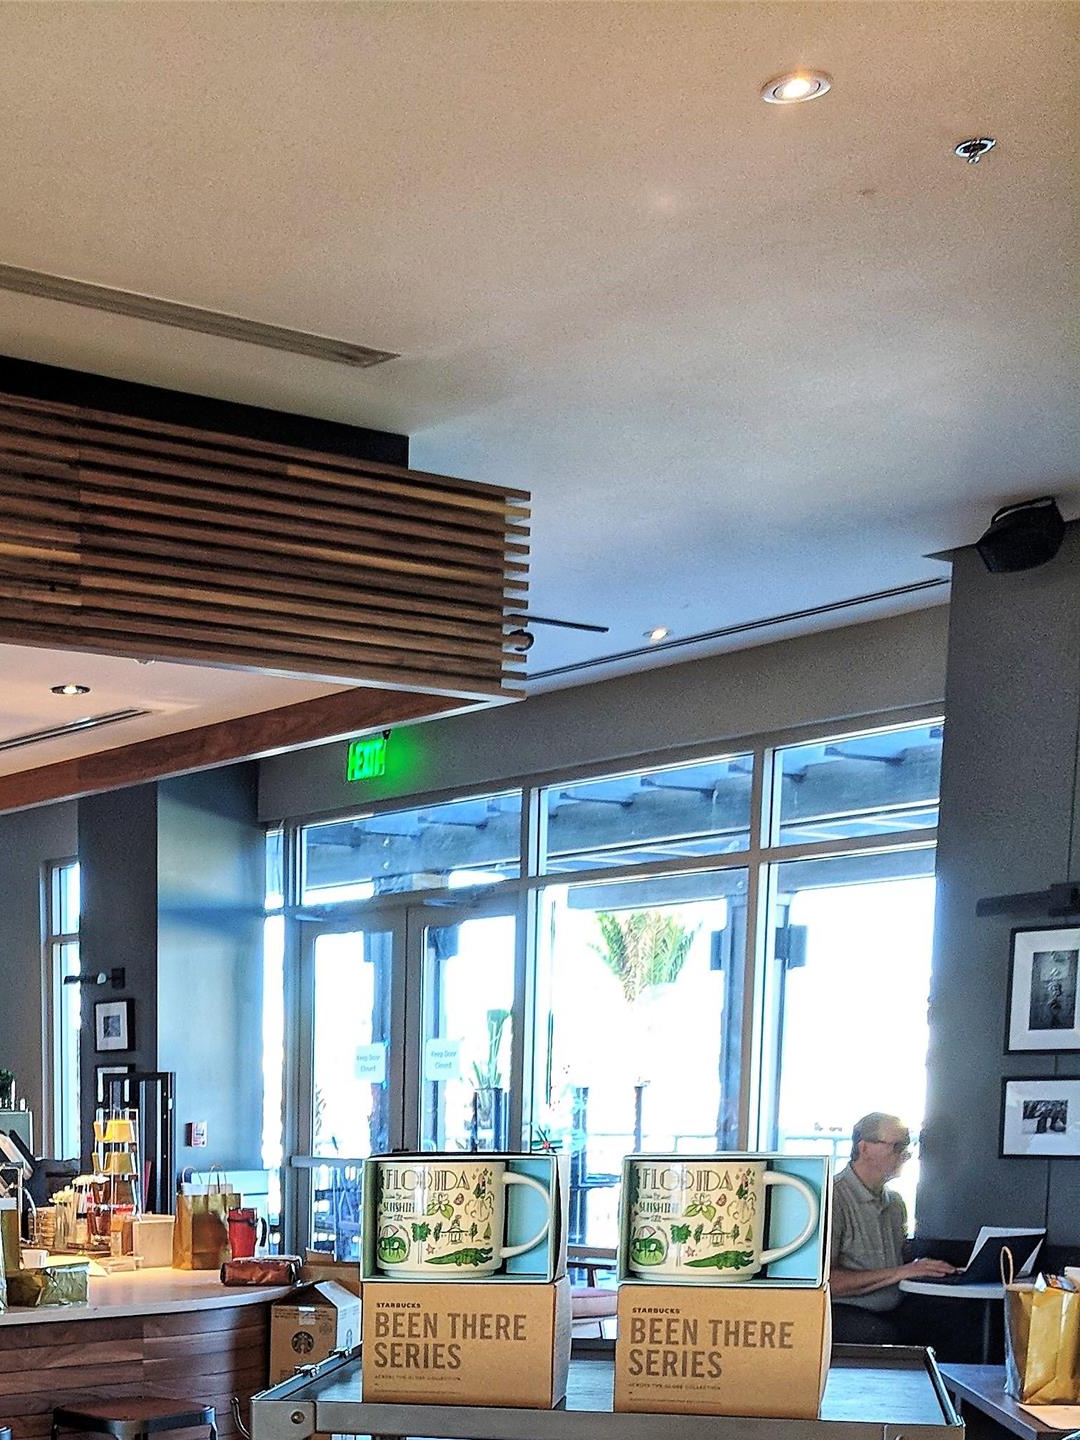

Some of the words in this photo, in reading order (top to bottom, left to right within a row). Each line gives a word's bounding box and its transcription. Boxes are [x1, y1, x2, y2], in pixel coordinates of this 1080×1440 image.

[375, 1312, 438, 1339] BEEN
[447, 1313, 527, 1341] THERE
[630, 1317, 698, 1346] BEEN
[708, 1319, 795, 1349] THERE
[374, 1342, 461, 1369] SERIES
[628, 1349, 722, 1378] SERIES
